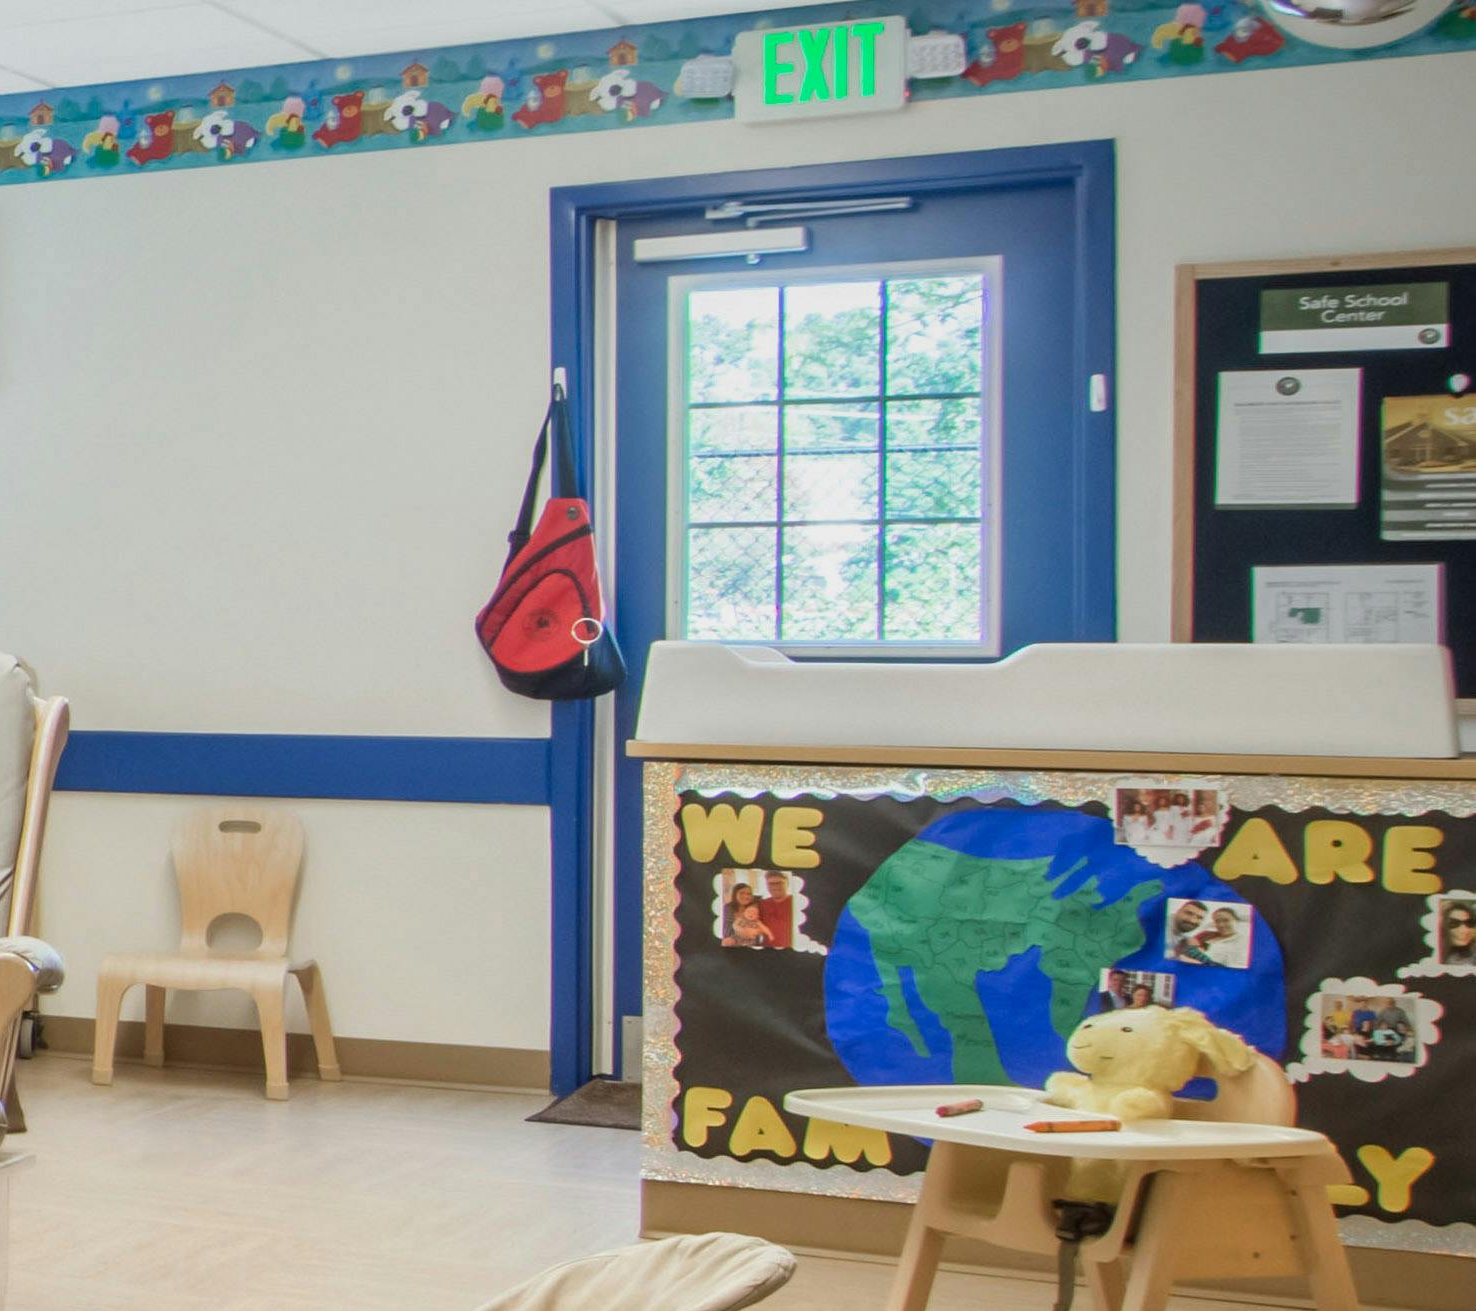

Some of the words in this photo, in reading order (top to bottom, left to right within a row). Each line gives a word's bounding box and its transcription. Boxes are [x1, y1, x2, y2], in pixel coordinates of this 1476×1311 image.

[763, 22, 885, 105] EXIT
[1299, 294, 1340, 310] Safe
[1344, 292, 1409, 308] School
[1321, 309, 1386, 323] Center
[681, 803, 825, 869] WE
[1212, 817, 1447, 895] ARE
